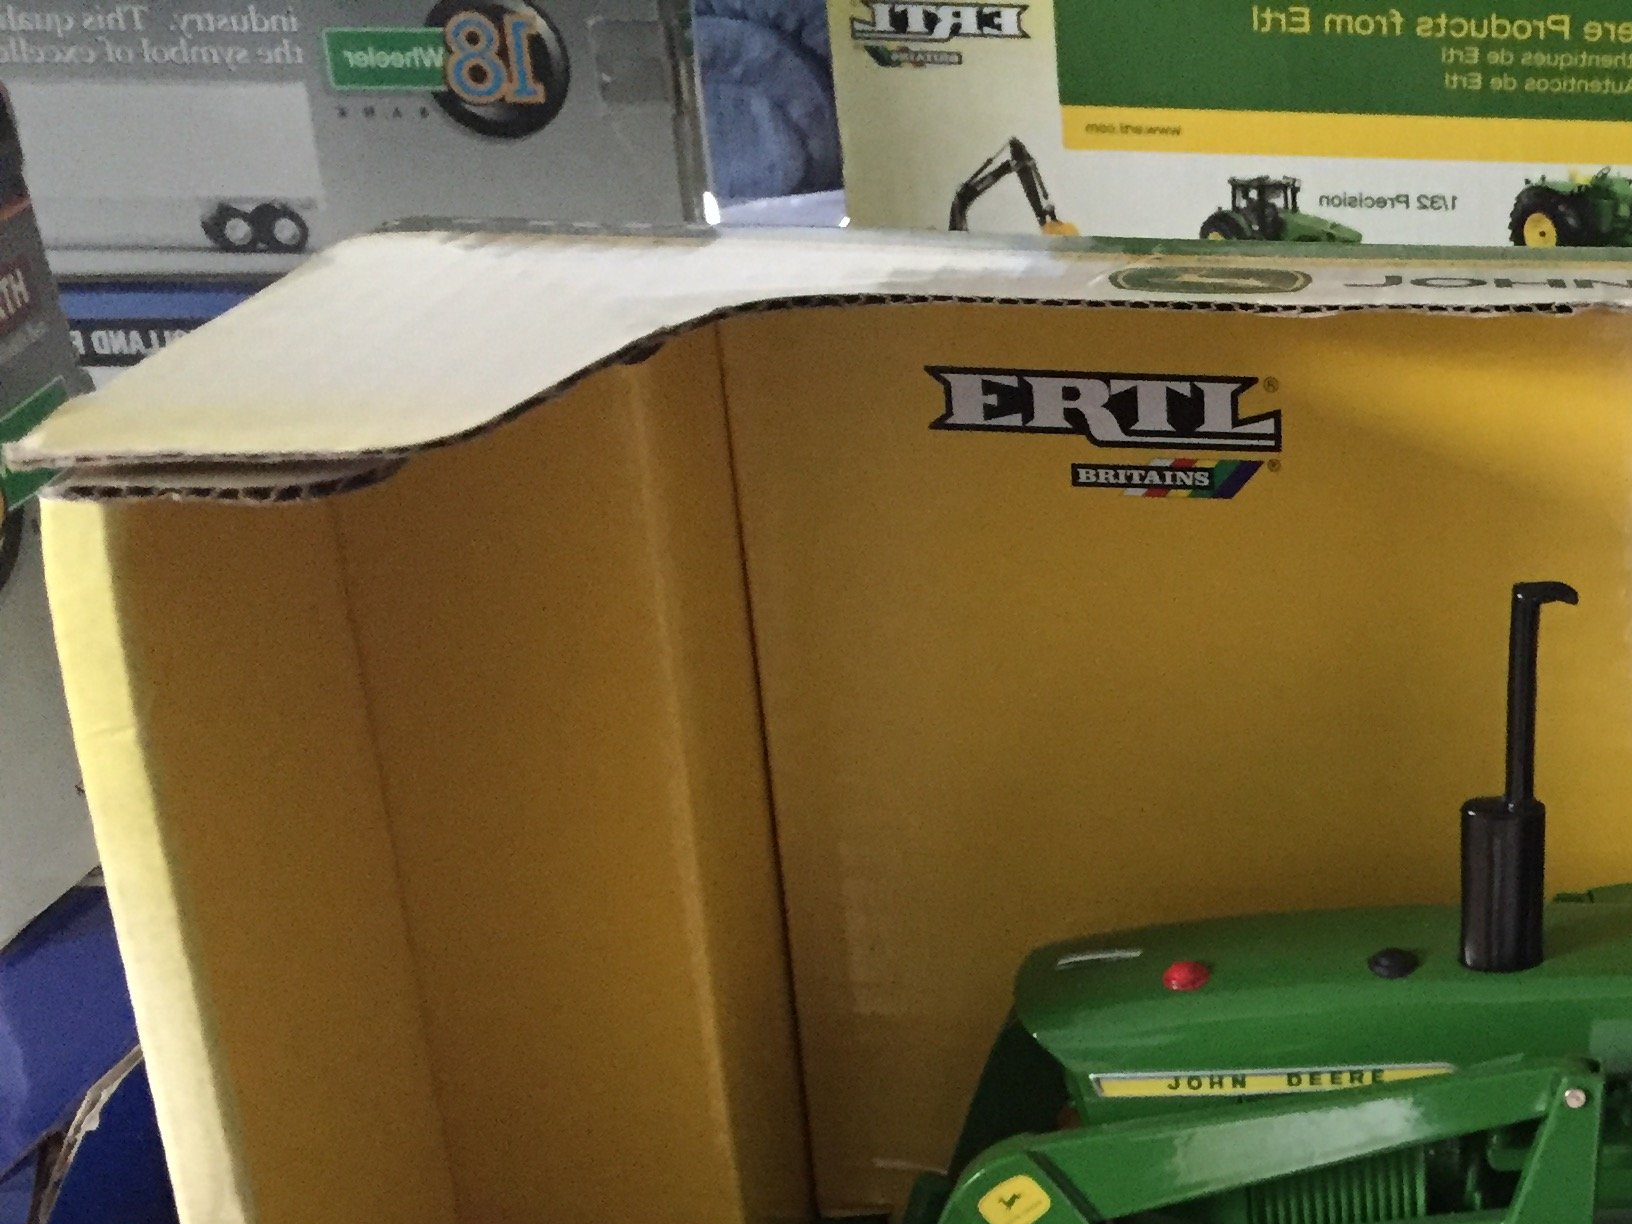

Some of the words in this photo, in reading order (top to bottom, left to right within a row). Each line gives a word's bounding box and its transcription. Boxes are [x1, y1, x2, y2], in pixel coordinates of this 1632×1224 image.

[930, 368, 1281, 450] ERTL
[1076, 466, 1211, 488] BRITAINS
[1167, 1073, 1247, 1091] JOHN
[1286, 1068, 1385, 1086] DEERE
